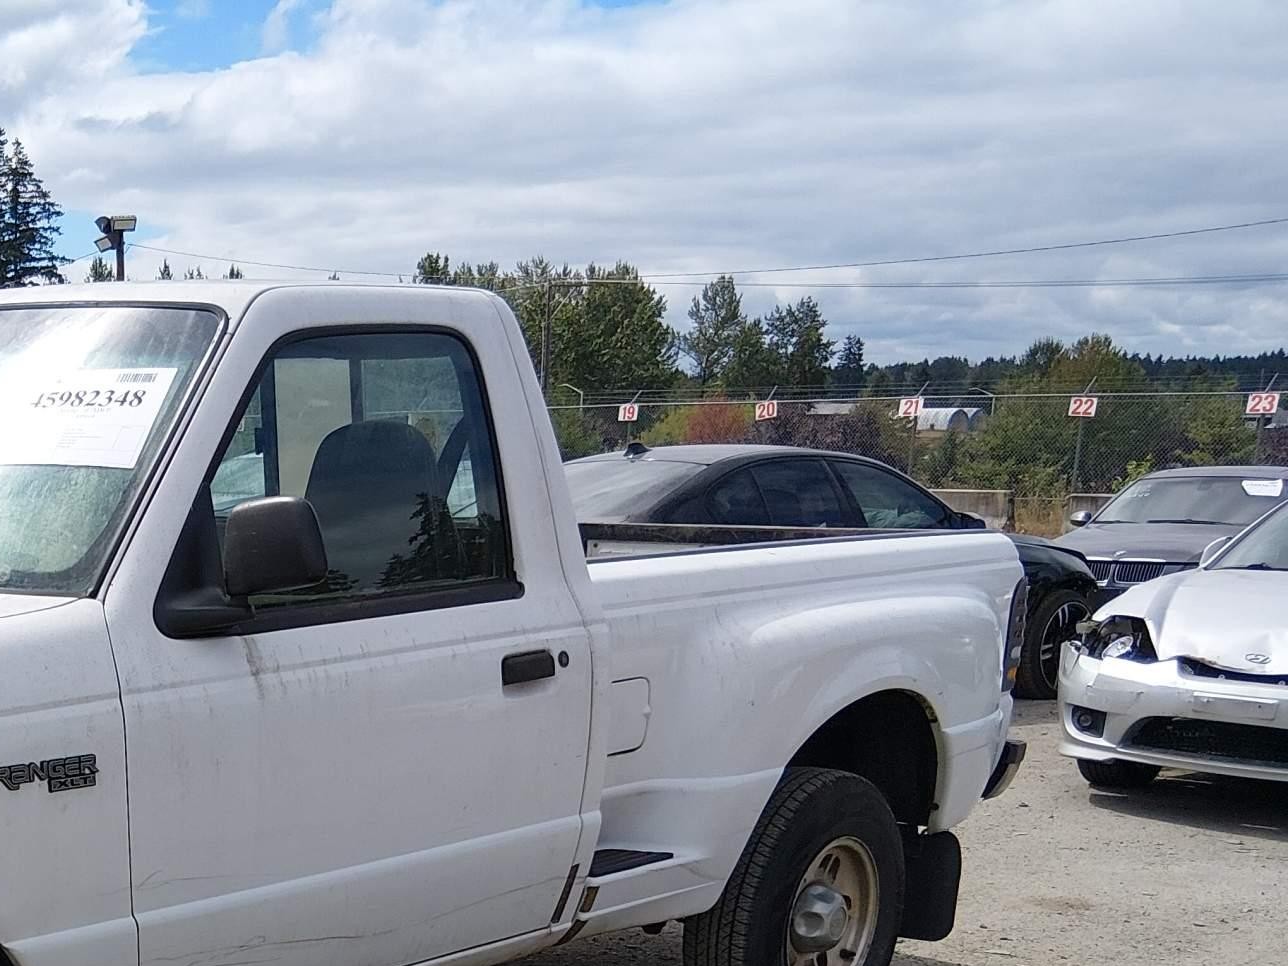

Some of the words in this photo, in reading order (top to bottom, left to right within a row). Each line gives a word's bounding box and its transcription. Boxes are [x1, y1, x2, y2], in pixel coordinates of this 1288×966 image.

[758, 402, 775, 418] 20
[903, 400, 920, 415] 21
[1070, 399, 1094, 416] 22
[1249, 394, 1276, 413] 23
[622, 406, 635, 420] 19
[52, 775, 96, 791] XLT
